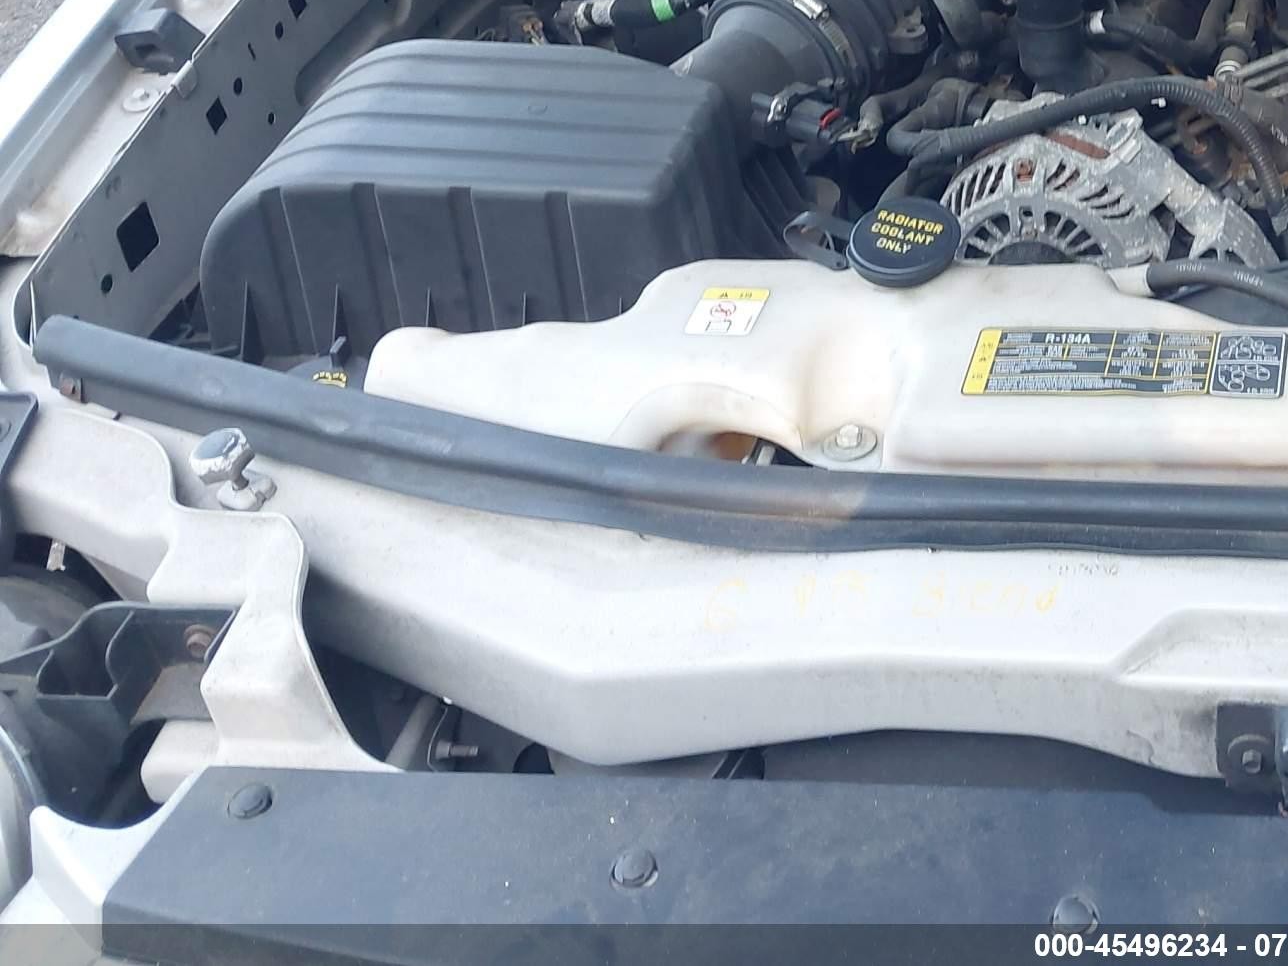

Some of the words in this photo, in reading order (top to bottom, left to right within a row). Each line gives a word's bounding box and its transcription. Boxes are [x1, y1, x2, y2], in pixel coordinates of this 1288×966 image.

[871, 222, 934, 246] COOLANT
[877, 210, 943, 235] RADIATOR
[876, 237, 911, 254] ONLY
